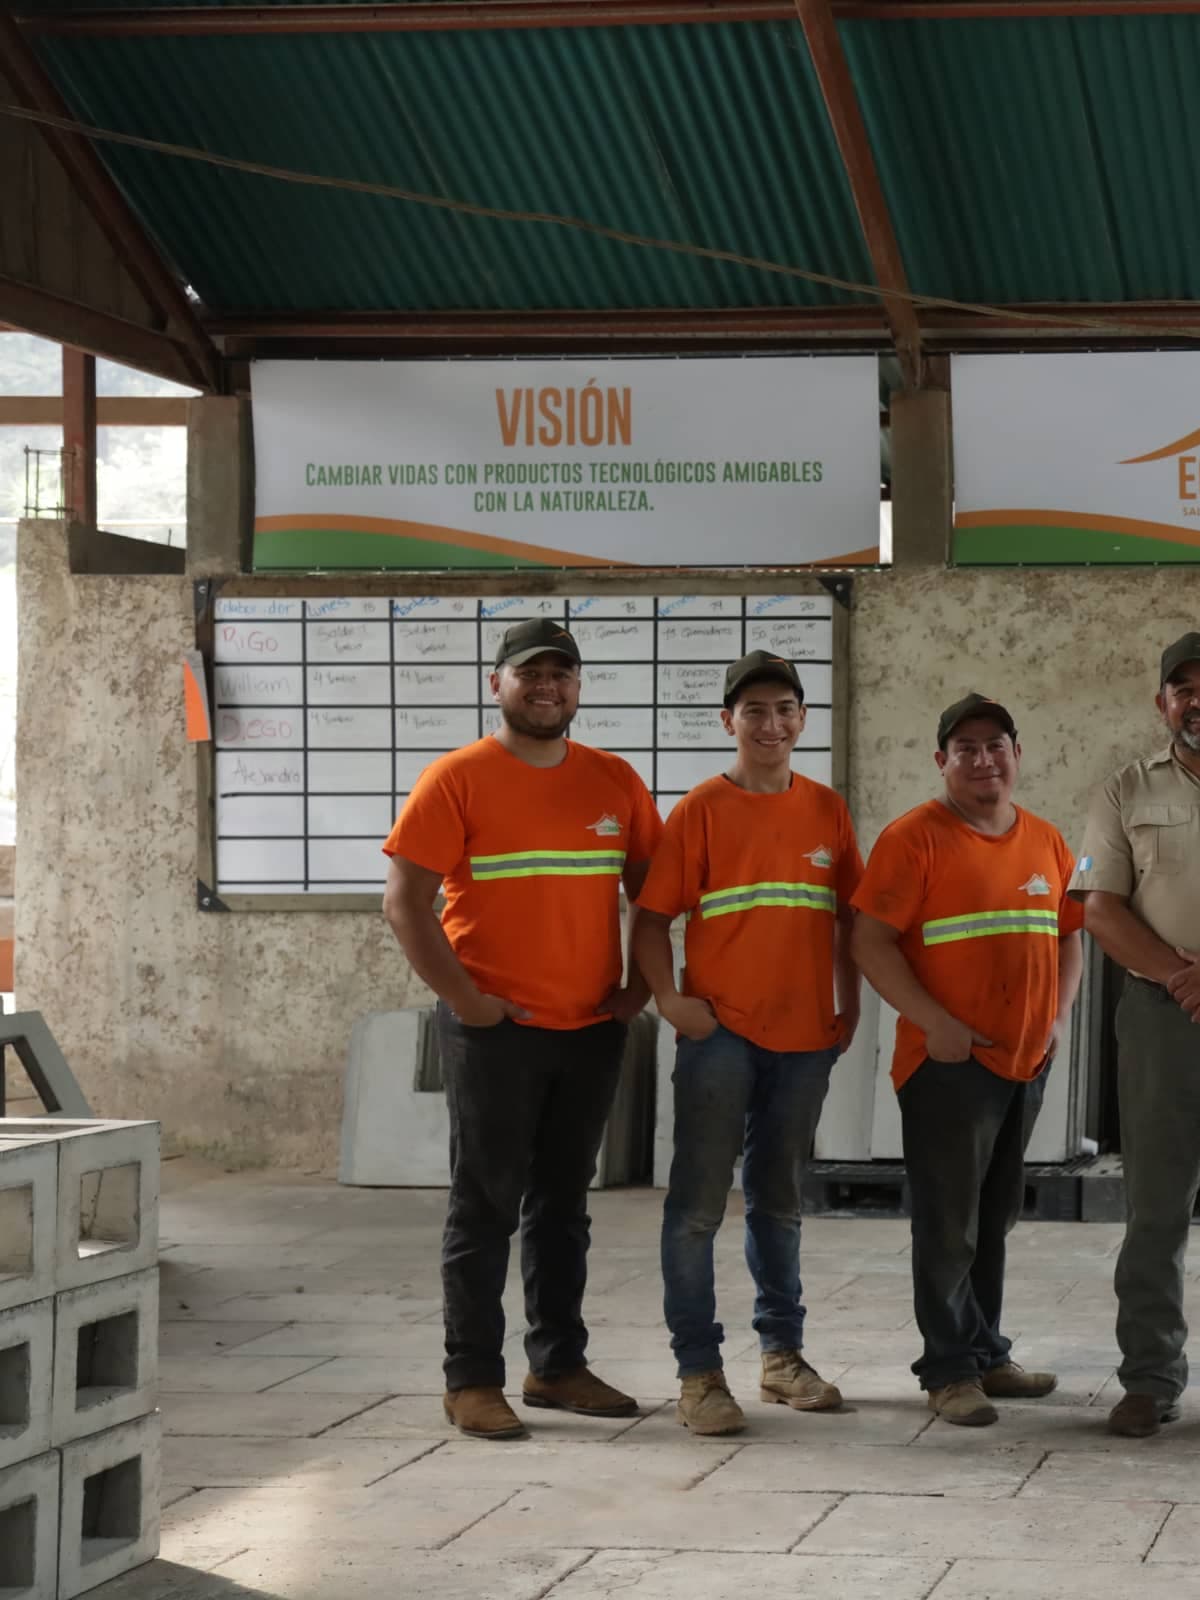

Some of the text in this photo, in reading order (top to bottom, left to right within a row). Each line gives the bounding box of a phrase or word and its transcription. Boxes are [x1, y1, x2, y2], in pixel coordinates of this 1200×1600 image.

[495, 378, 633, 447] VISIÓN
[388, 463, 439, 485] VIDAS
[444, 463, 477, 485] CON
[484, 462, 583, 484] PRODUCTOS
[589, 459, 717, 484] TECNOLÓGICOS
[722, 461, 824, 483] AMIGABLES
[473, 490, 655, 512] CON LA NATURALEZA.
